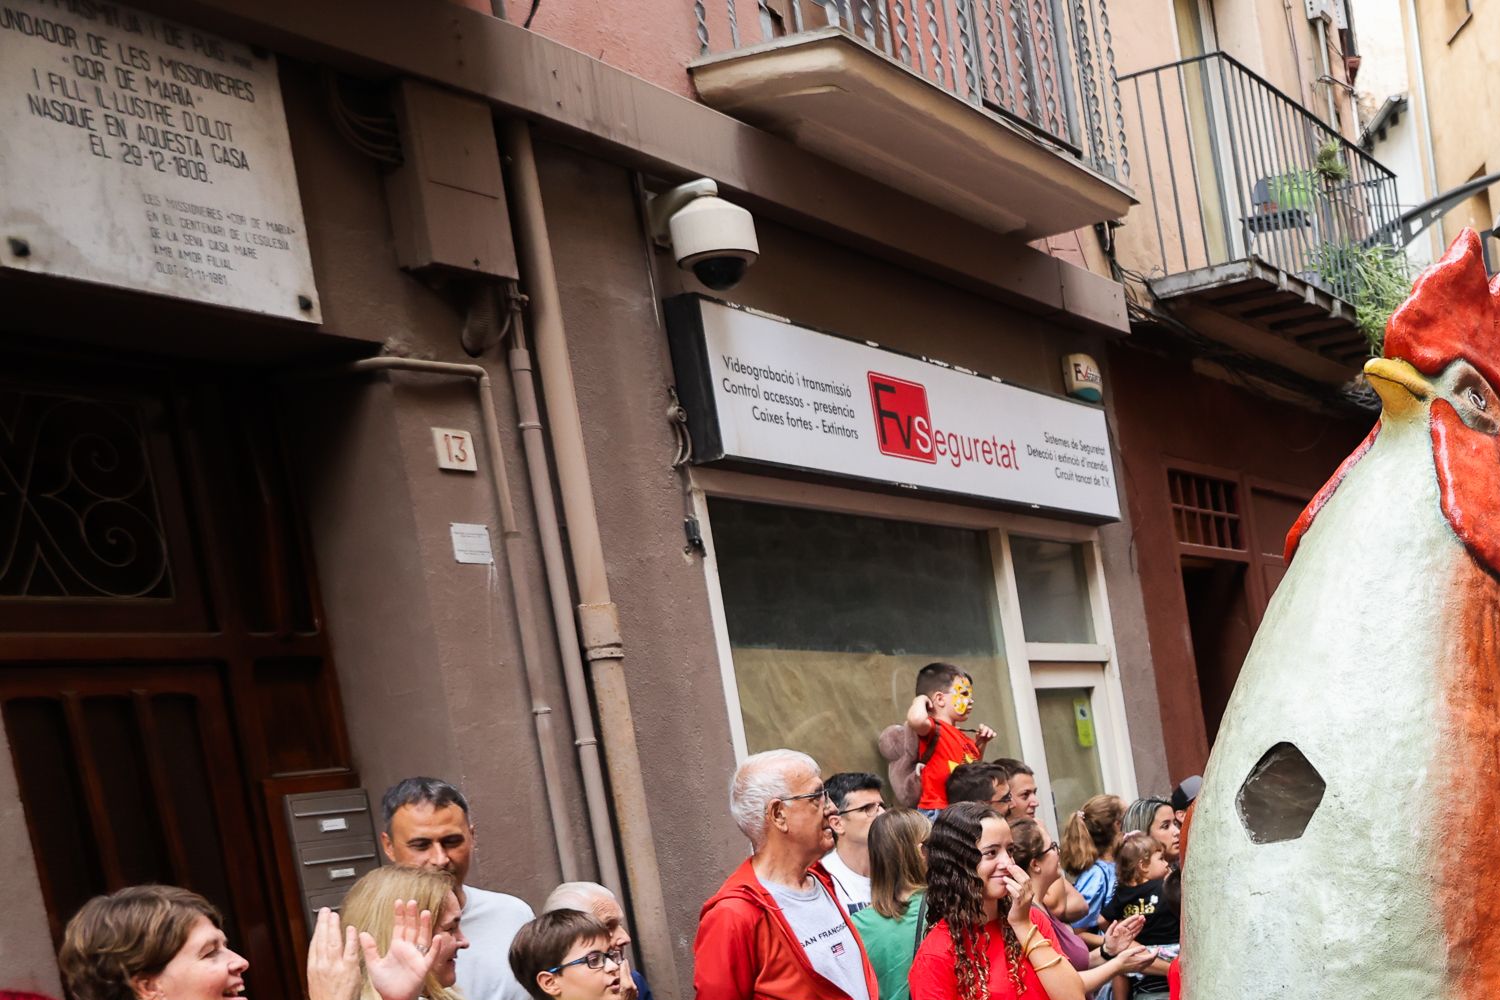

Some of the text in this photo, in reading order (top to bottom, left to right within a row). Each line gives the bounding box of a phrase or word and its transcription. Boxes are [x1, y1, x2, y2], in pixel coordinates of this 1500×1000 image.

[87, 32, 112, 60] DE
[117, 42, 151, 72] LES
[158, 55, 255, 103] MISSIONERES
[114, 66, 139, 93] DE
[32, 67, 41, 90] I
[48, 72, 88, 104] FILL
[89, 133, 112, 159] EL
[104, 113, 128, 140] EN
[137, 123, 204, 159] AQUESTA
[210, 143, 250, 172] CASA
[722, 354, 795, 386] Videograbació
[802, 375, 852, 398] transmissió
[722, 377, 761, 399] Control
[763, 390, 805, 408] accessos
[813, 400, 855, 419] presència
[752, 405, 785, 426] Caixes
[786, 411, 813, 431] fortes
[821, 419, 859, 440] Extintors
[444, 433, 467, 462] 13
[1026, 444, 1054, 461] Detecció
[1044, 431, 1105, 456] Sistemes de Seguretat
[1093, 475, 1101, 487] de
